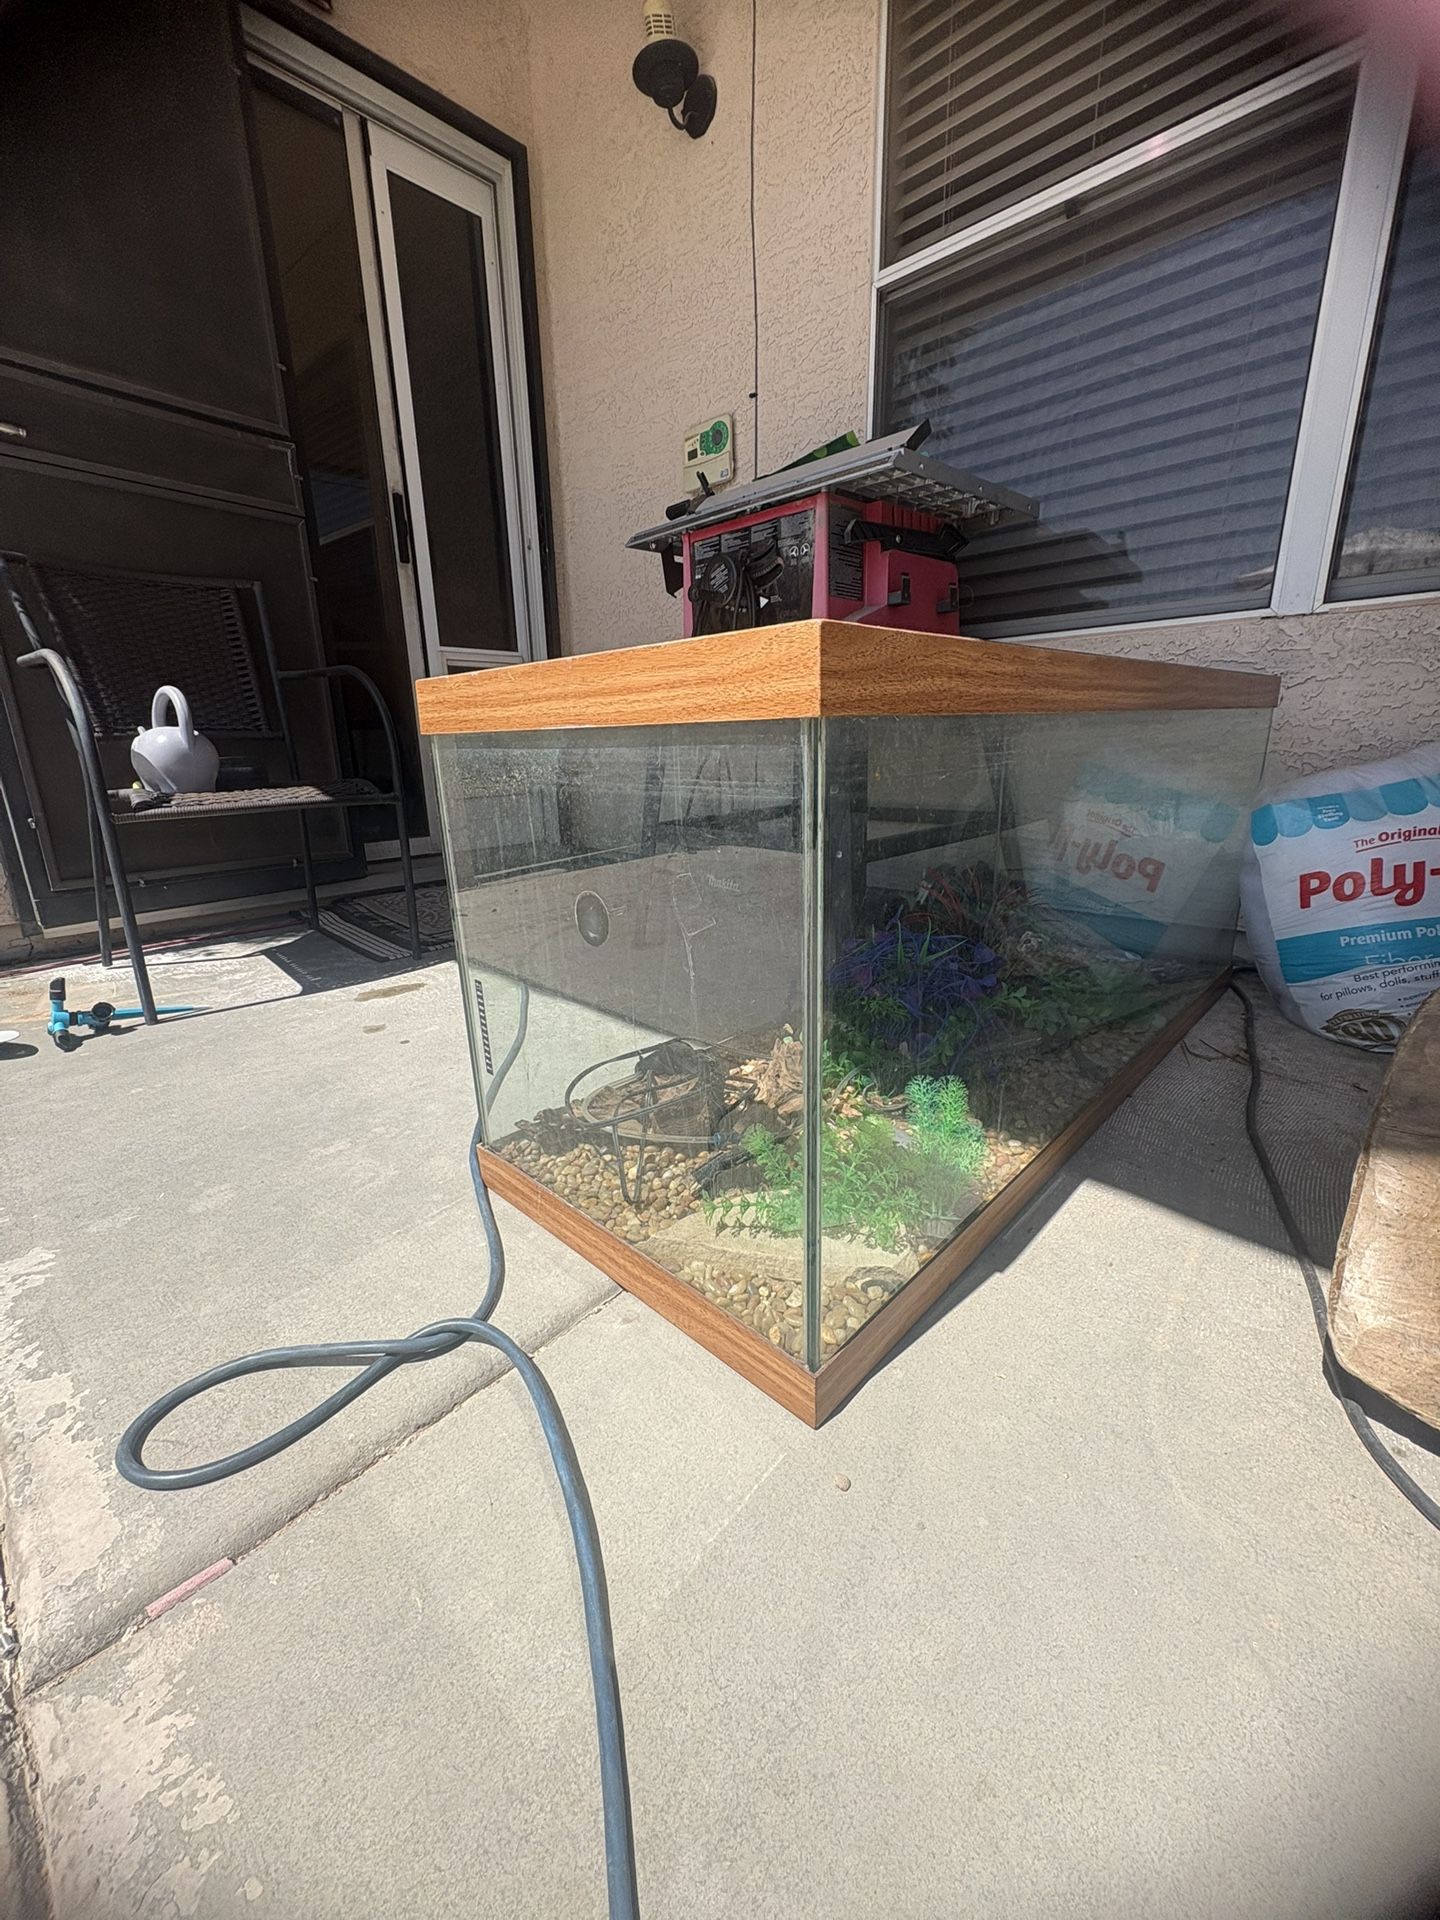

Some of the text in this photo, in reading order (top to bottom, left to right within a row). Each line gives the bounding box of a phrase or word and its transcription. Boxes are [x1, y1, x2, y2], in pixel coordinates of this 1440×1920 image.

[1353, 837, 1375, 848] The
[1340, 928, 1412, 947] Premium
[1353, 971, 1380, 982] Best
[1320, 992, 1333, 1001] for
[1335, 982, 1377, 1000] pillows,
[1379, 976, 1410, 989] dolls,
